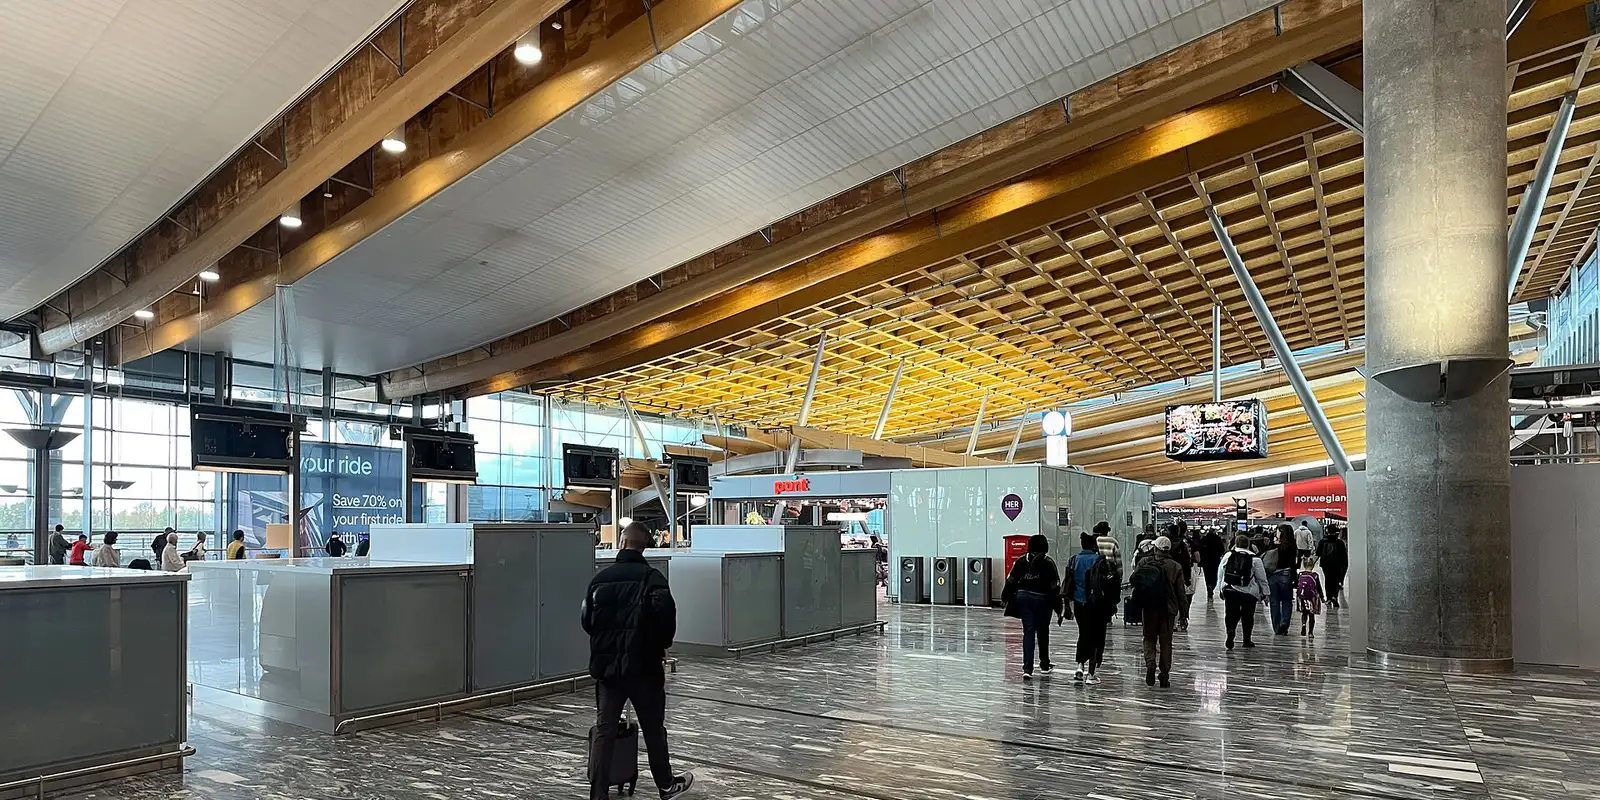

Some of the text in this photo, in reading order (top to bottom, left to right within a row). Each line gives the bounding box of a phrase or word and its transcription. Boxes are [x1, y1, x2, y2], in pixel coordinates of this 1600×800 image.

[339, 455, 372, 475] ride
[333, 494, 403, 508] Save 70% on
[1294, 494, 1347, 504] norwegian
[333, 513, 403, 528] your first ride
